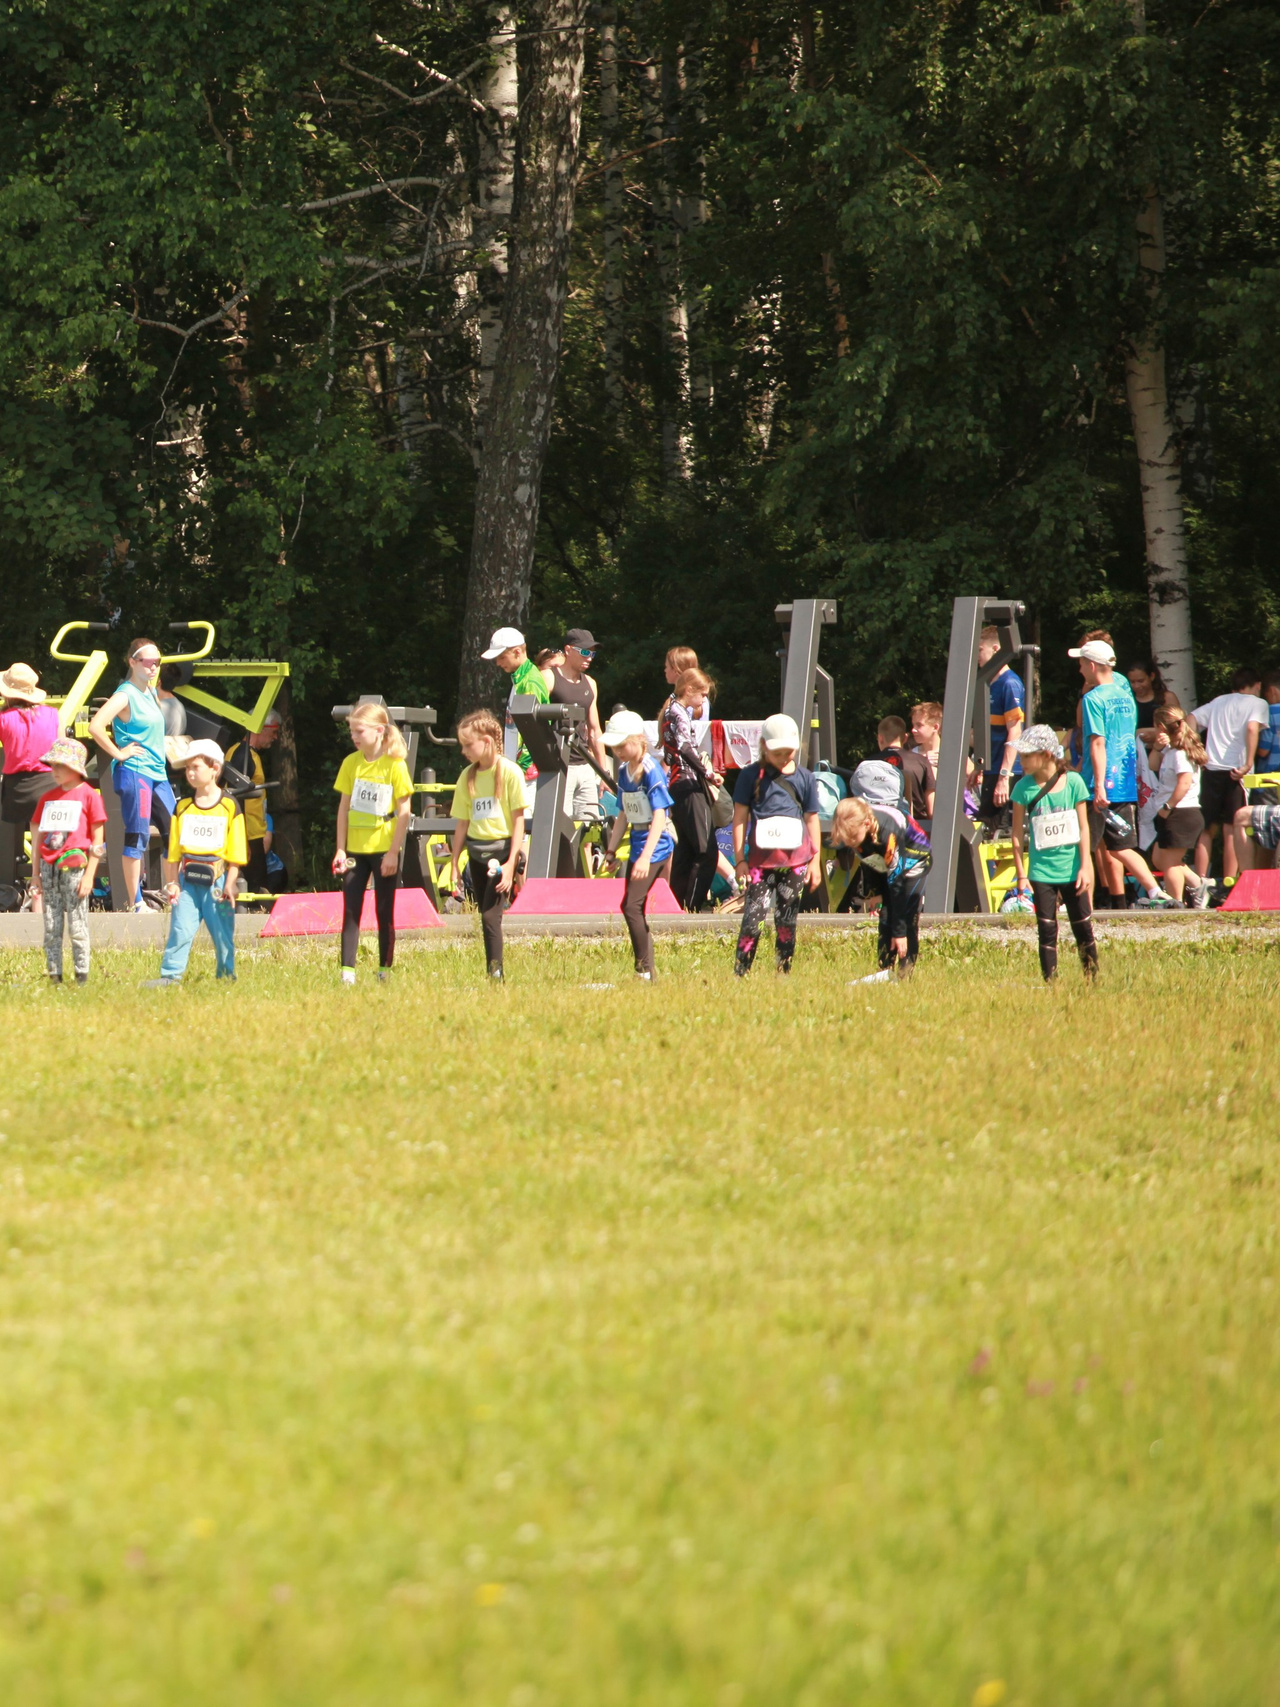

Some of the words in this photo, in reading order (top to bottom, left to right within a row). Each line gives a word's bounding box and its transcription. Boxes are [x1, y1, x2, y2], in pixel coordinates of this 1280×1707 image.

[360, 790, 378, 802] 614
[475, 800, 492, 811] 611
[50, 811, 68, 821] 601
[193, 826, 213, 837] 605
[1044, 823, 1066, 837] 607
